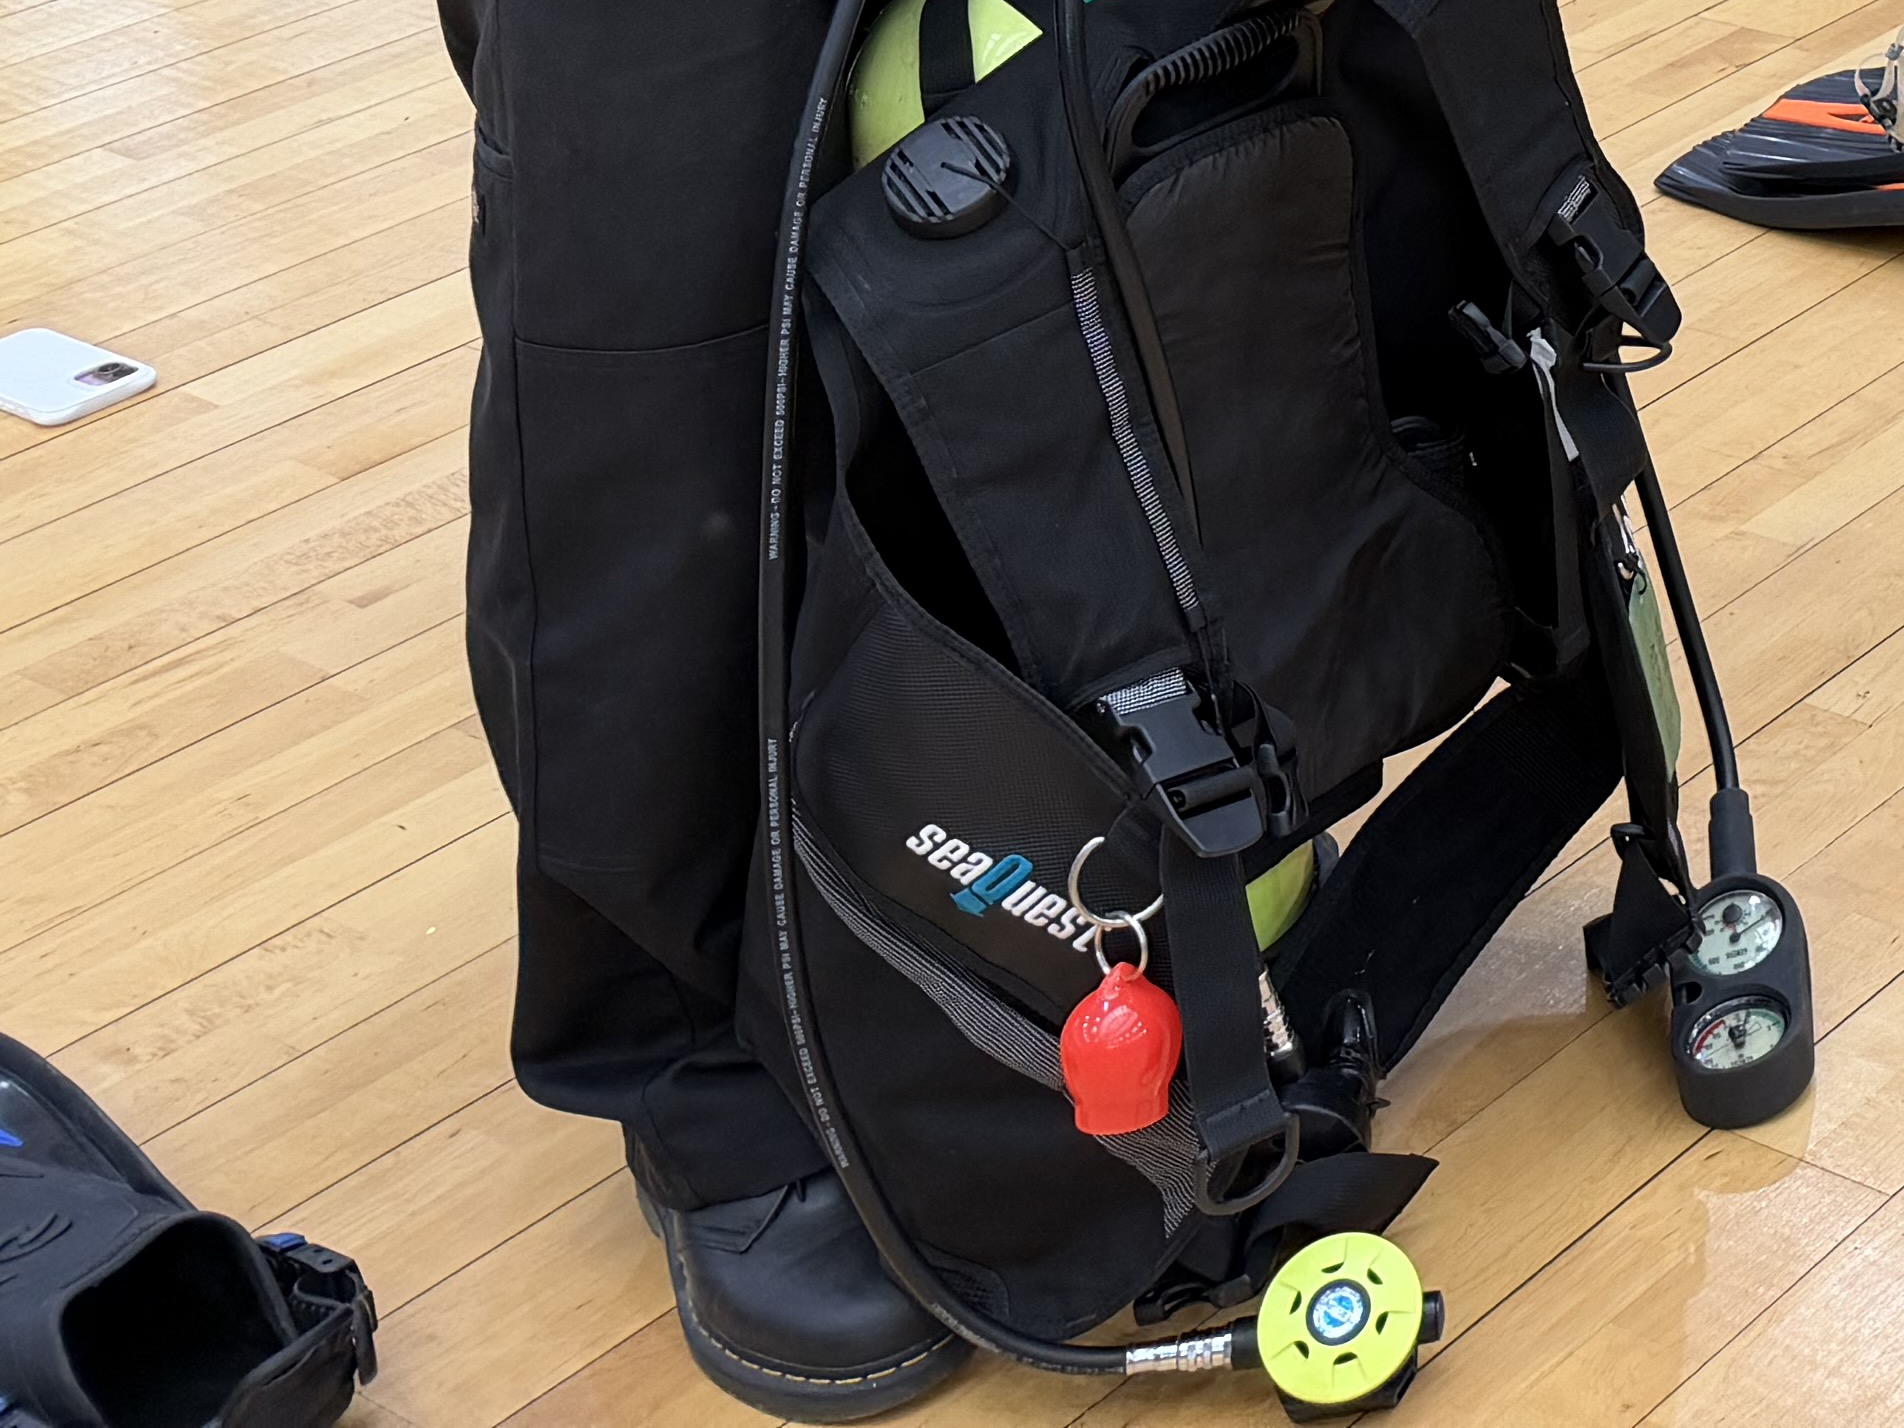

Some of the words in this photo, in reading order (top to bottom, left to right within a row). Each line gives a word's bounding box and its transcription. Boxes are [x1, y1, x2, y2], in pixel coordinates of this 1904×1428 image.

[789, 211, 804, 254] DAMAGE
[784, 255, 798, 291] CAUSE
[783, 293, 794, 316] MAY
[781, 318, 792, 336] PSI
[772, 463, 783, 486] NOT
[767, 775, 779, 828] PERSONAL
[770, 828, 781, 846] OR
[771, 847, 782, 891] DAMAGE
[774, 892, 785, 927] CAUSE
[778, 929, 790, 952] MAY
